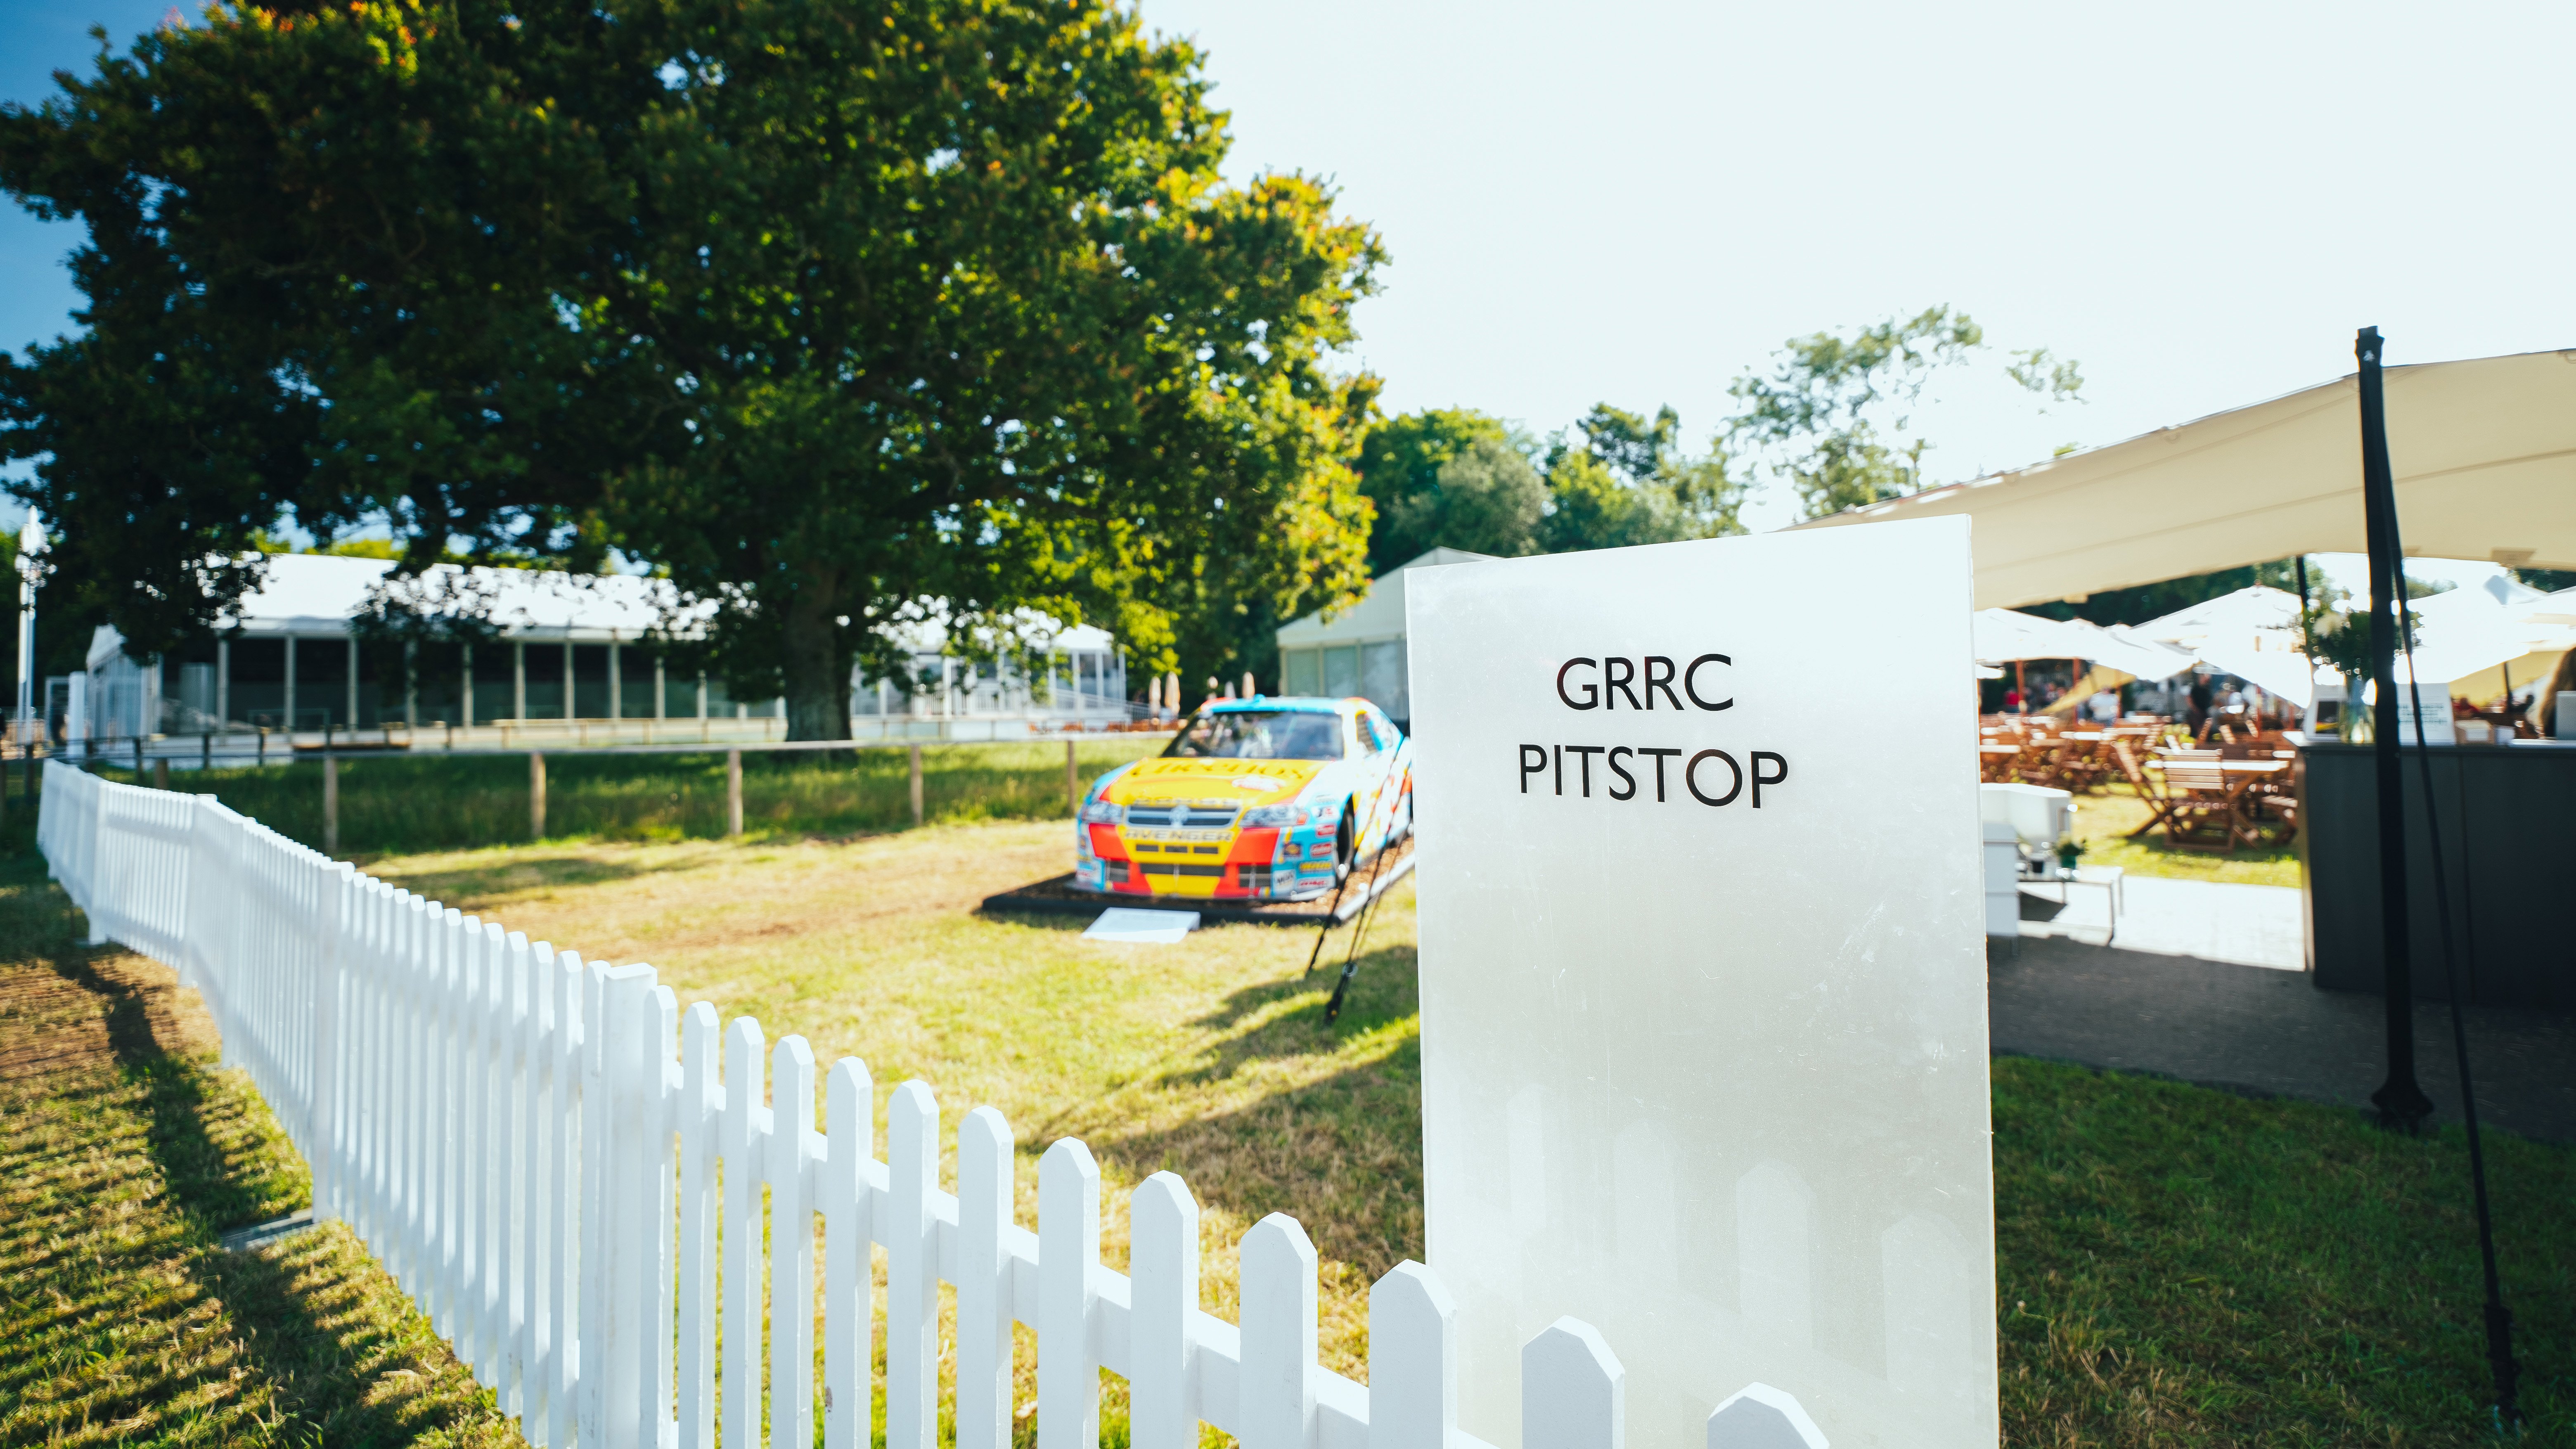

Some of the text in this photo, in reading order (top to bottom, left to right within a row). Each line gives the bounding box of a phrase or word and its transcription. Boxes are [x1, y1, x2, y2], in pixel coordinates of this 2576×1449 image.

[1557, 653, 1733, 711] GRRC
[1519, 744, 1788, 809] PITSTOP
[1125, 829, 1233, 841] AVENGER
